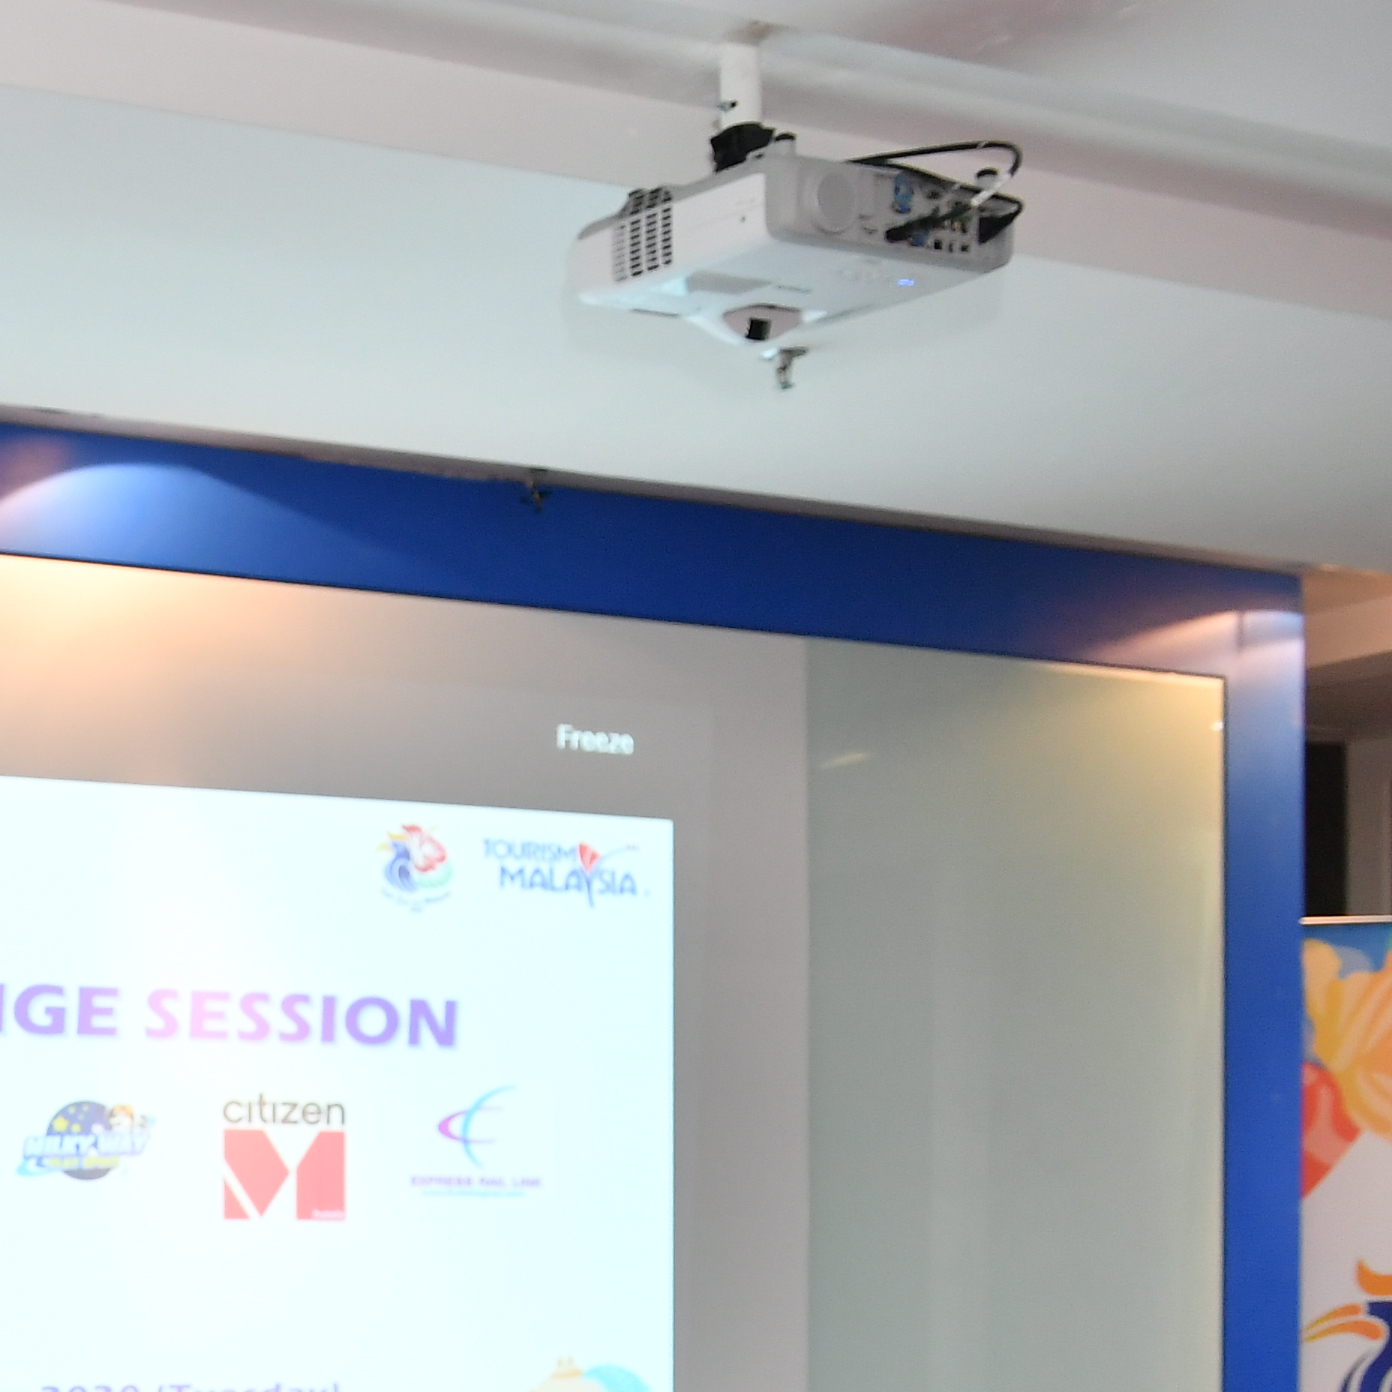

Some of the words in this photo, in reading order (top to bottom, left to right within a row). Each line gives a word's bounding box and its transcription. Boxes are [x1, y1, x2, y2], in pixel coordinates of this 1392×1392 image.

[556, 723, 634, 755] Freeze
[483, 838, 578, 863] TOURISM
[500, 866, 637, 907] MALAYSIA
[144, 987, 459, 1048] SESSION
[222, 1092, 346, 1125] citizen
